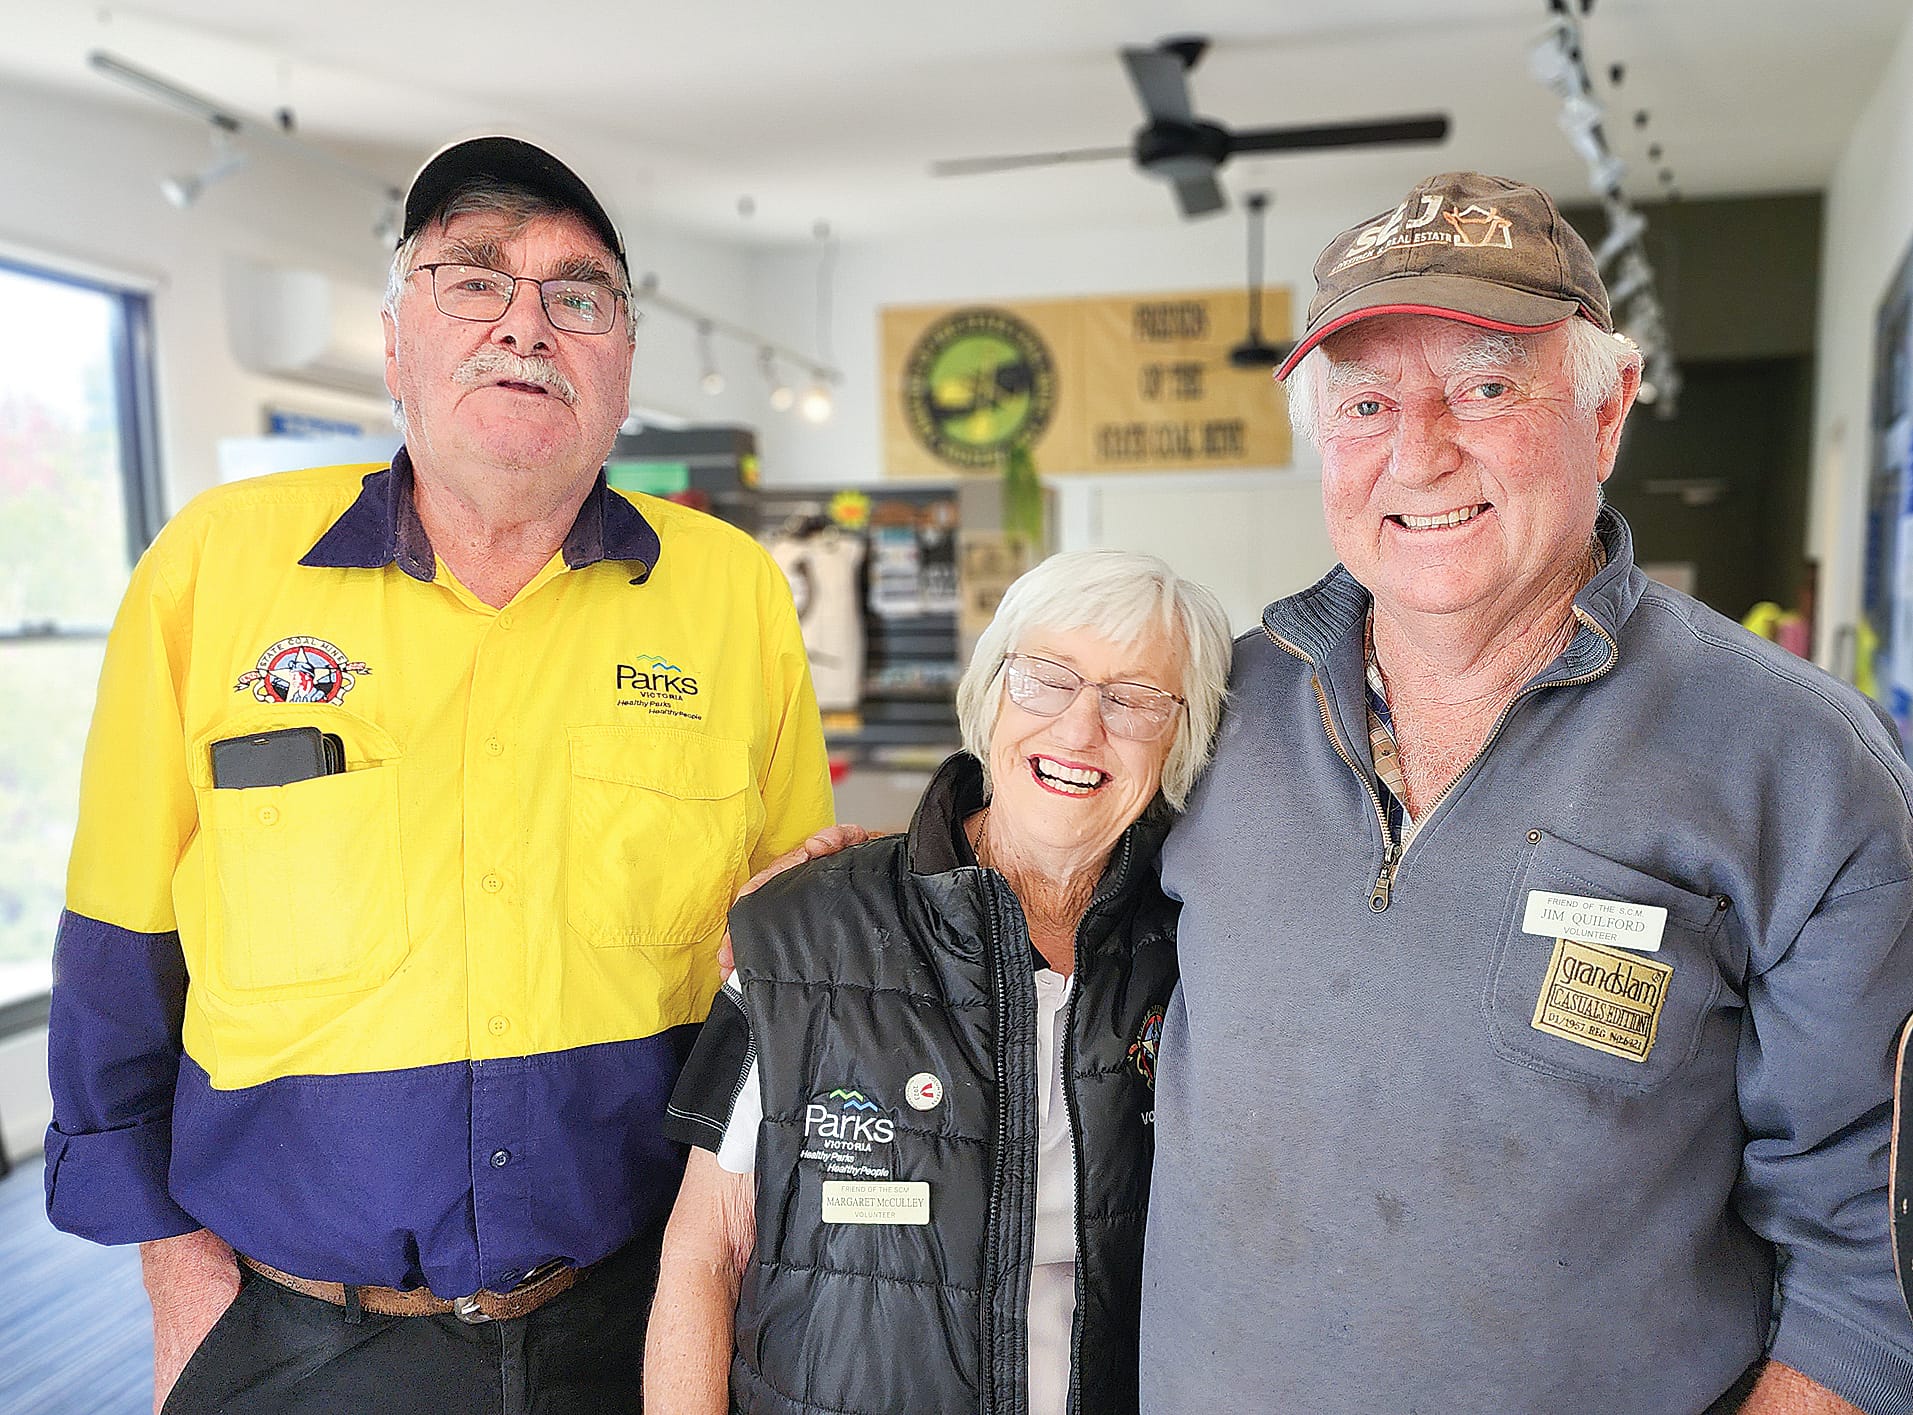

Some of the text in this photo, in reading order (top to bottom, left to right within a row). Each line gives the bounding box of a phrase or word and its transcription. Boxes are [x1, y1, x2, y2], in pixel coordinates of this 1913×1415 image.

[260, 637, 346, 667] STATE COAL MINE
[616, 664, 698, 695] Parks
[617, 699, 672, 708] Healthy Parks
[640, 691, 684, 701] VICTORIA
[1547, 897, 1645, 918] FRIEND OF THE S.C.M.
[1540, 908, 1646, 933] JIM QUILFORD
[1563, 926, 1618, 942] VOLUNTEER
[1559, 956, 1657, 1010] grandslam
[1552, 988, 1607, 1020] CASUALS
[1588, 1025, 1606, 1038] REG
[804, 1104, 894, 1144] Parks
[823, 1140, 872, 1152] VICTORIA
[800, 1149, 855, 1163] Healthy Parks
[841, 1185, 866, 1193] FRIEND
[826, 1197, 925, 1208] MARGARET McCULLEY
